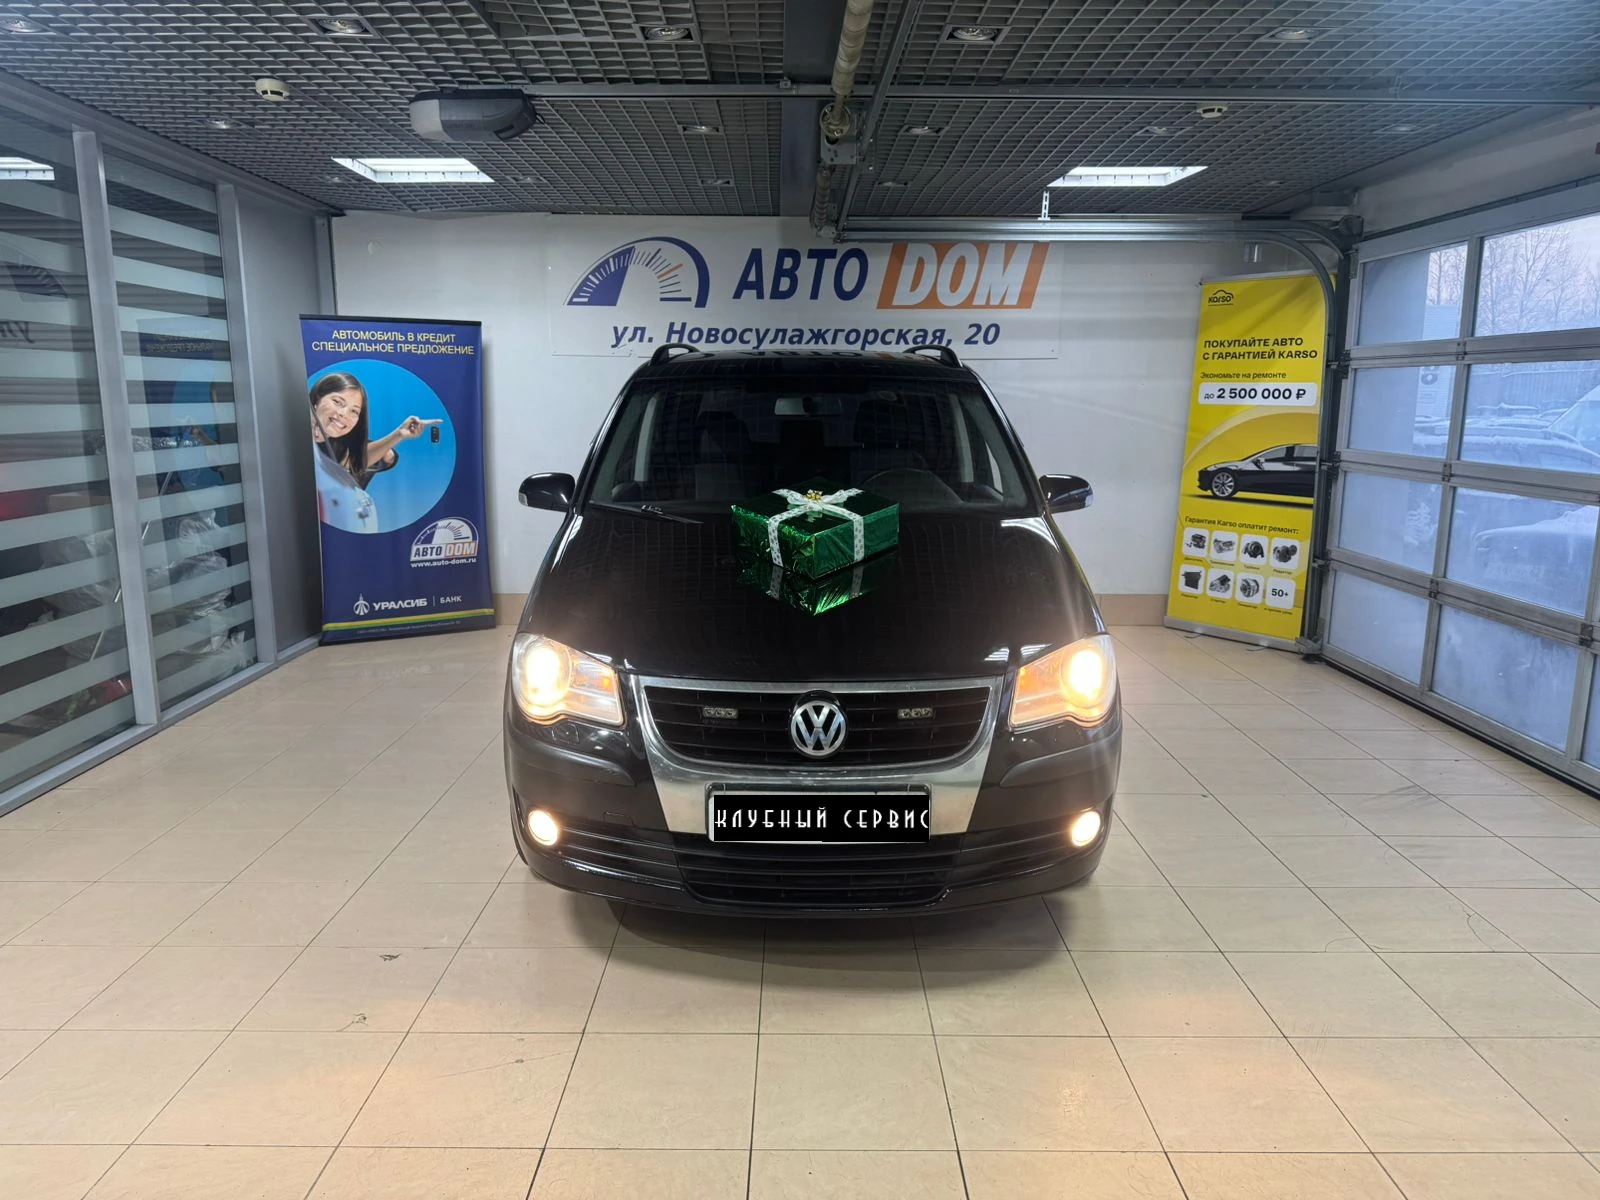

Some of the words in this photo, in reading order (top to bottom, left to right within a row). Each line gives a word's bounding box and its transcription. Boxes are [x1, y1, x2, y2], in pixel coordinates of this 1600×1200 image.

[732, 247, 869, 301] АВТО
[892, 243, 1034, 307] DOM
[332, 330, 405, 342] АВТОМОБИЛЬ
[408, 333, 415, 342] В
[417, 333, 456, 344] КРЕДИТ
[611, 325, 654, 348] ул.
[665, 322, 952, 349] Новосулажгорская,
[964, 322, 1000, 346] 20
[1204, 337, 1270, 348] ПОКУПАЙТЕ
[1272, 337, 1303, 347] АВТО
[311, 341, 395, 353] СПЕЦИАЛЬНОЕ
[397, 343, 474, 355] ПРЕДЛОЖЕНИЕ
[1202, 352, 1210, 360] С
[1212, 349, 1276, 360] ГАРАНТИЕЙ
[1278, 350, 1318, 359] KARSO
[1252, 372, 1287, 380] ремонте
[1228, 388, 1258, 399] 500
[1261, 388, 1292, 400] 000
[1184, 516, 1217, 525] Гарантия
[1217, 519, 1238, 528] Karso
[1238, 522, 1267, 531] оплатит
[1268, 526, 1299, 534] ремонт:
[413, 545, 443, 558] АВТО
[444, 542, 476, 557] DOM
[410, 558, 477, 568] www.auto-dom.ru
[1271, 588, 1289, 598] 50+
[373, 599, 428, 611] УРАЛСИБ
[440, 596, 462, 604] БАНК
